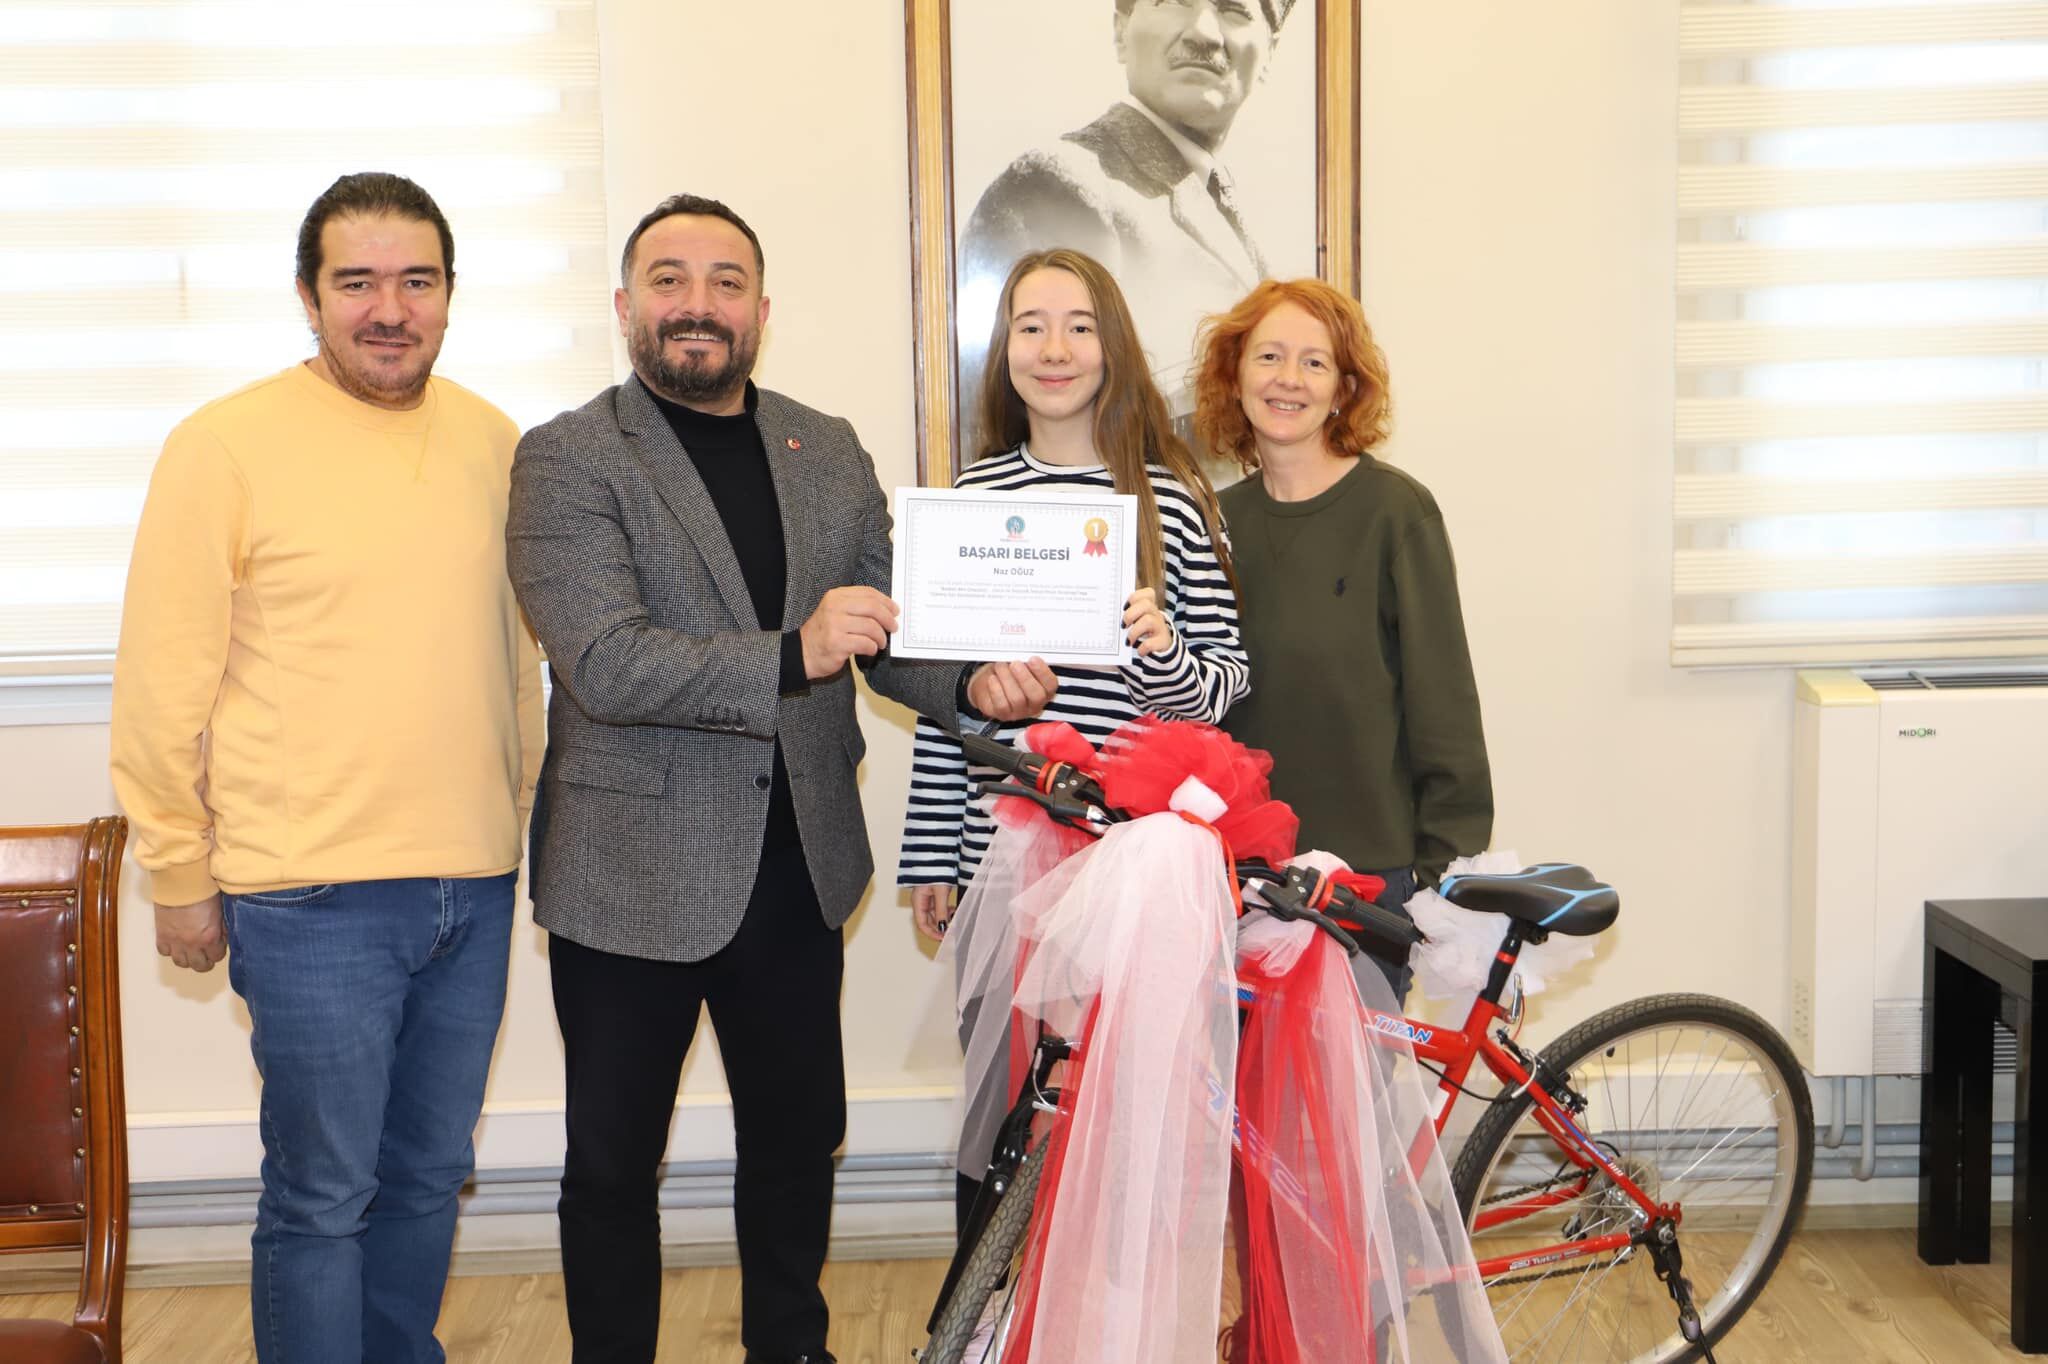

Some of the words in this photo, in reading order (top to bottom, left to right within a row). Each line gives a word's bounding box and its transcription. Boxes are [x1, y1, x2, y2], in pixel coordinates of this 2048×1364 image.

[1091, 523, 1099, 538] 1
[959, 546, 1010, 560] BAŞARI
[1014, 547, 1070, 560] BELGESİ
[993, 567, 1008, 575] Naz
[1010, 567, 1035, 576] OĞUZ
[1374, 1014, 1433, 1043] TITAN
